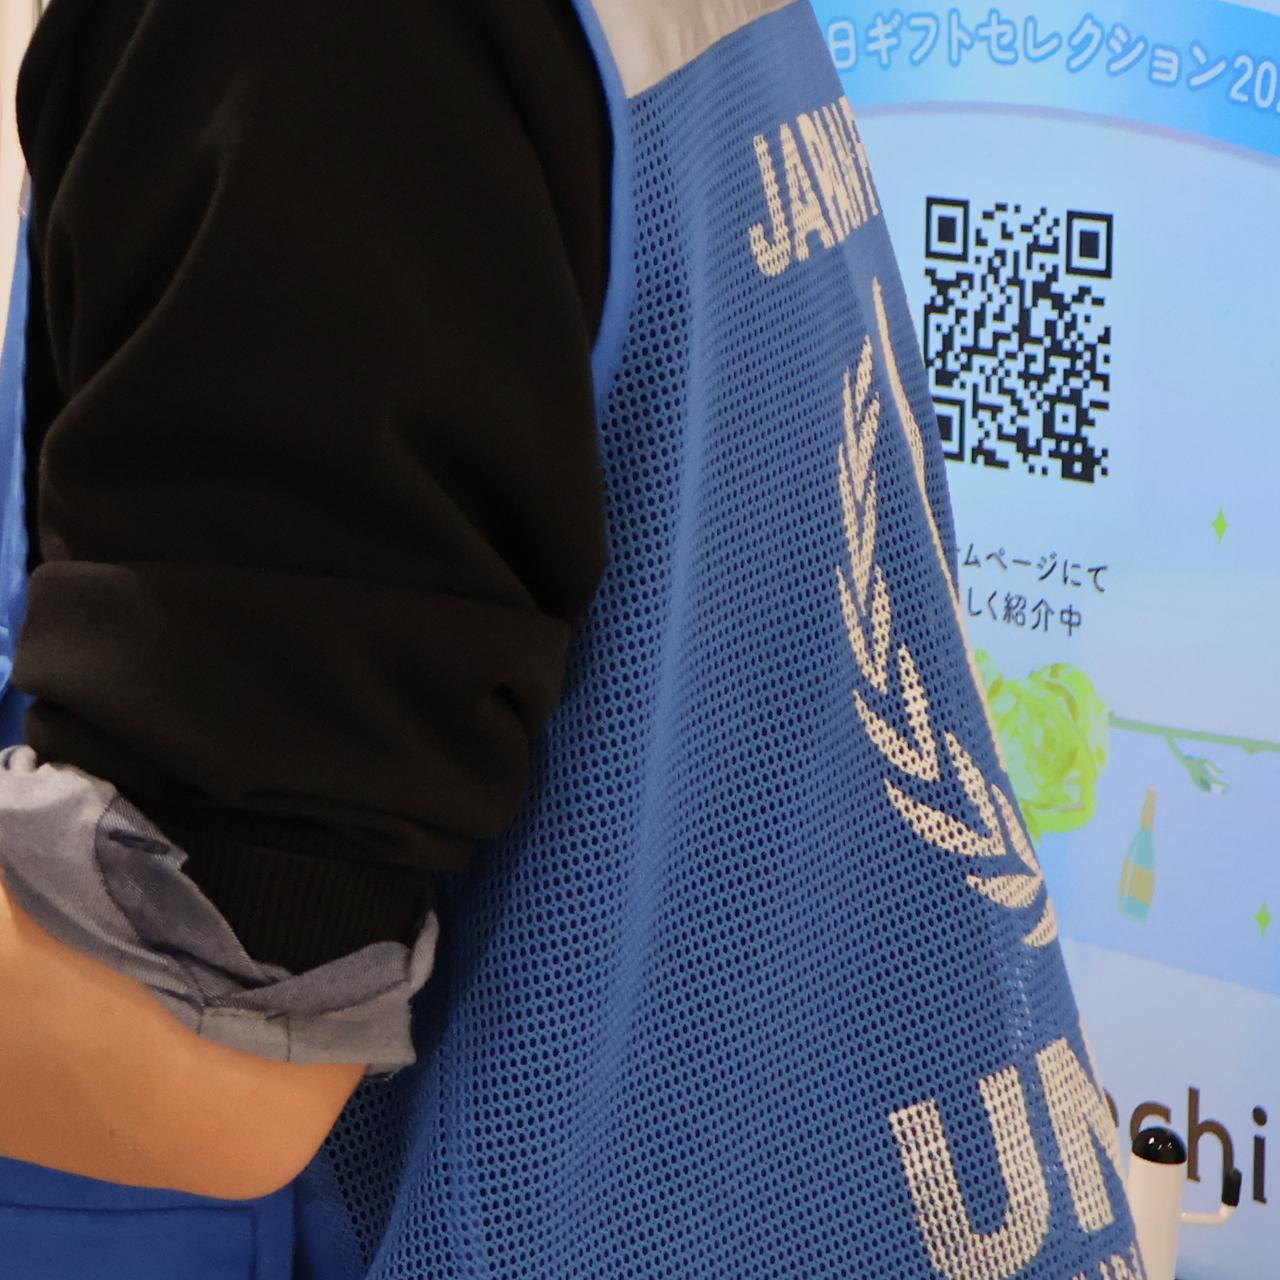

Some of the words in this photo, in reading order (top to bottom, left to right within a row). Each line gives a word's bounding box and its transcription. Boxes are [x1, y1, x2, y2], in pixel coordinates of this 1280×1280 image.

[827, 8, 1280, 115] 日ギフトセレクション20
[957, 542, 1108, 593] ムページにて
[968, 586, 1082, 637] しく紹介中
